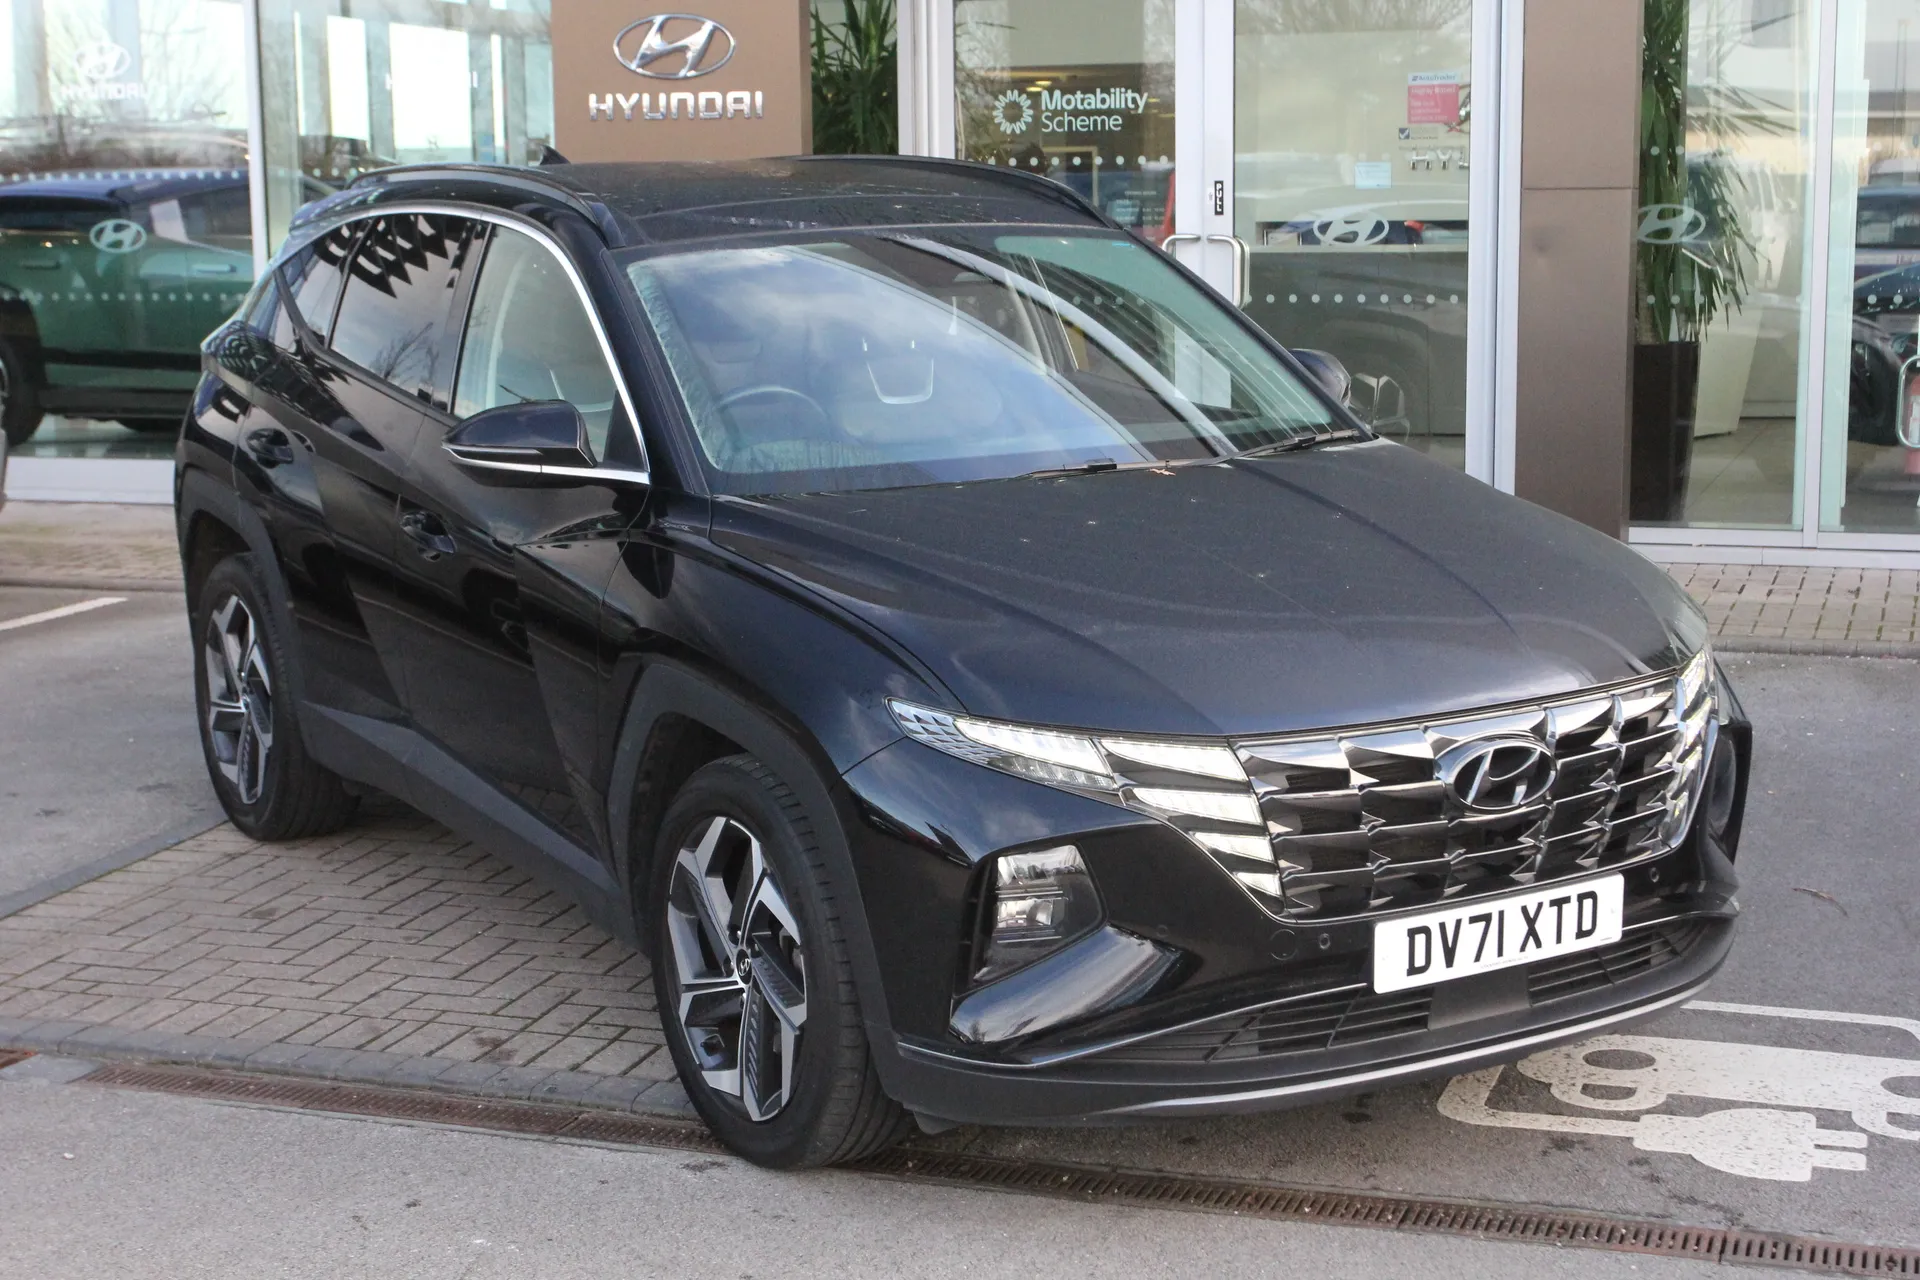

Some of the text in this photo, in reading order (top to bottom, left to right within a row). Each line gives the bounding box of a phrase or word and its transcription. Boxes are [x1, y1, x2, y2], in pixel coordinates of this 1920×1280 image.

[588, 91, 763, 121] HYUNDAI
[1041, 88, 1148, 114] Motability
[1041, 111, 1123, 133] Scheme
[1406, 890, 1598, 977] DV71 XTD
